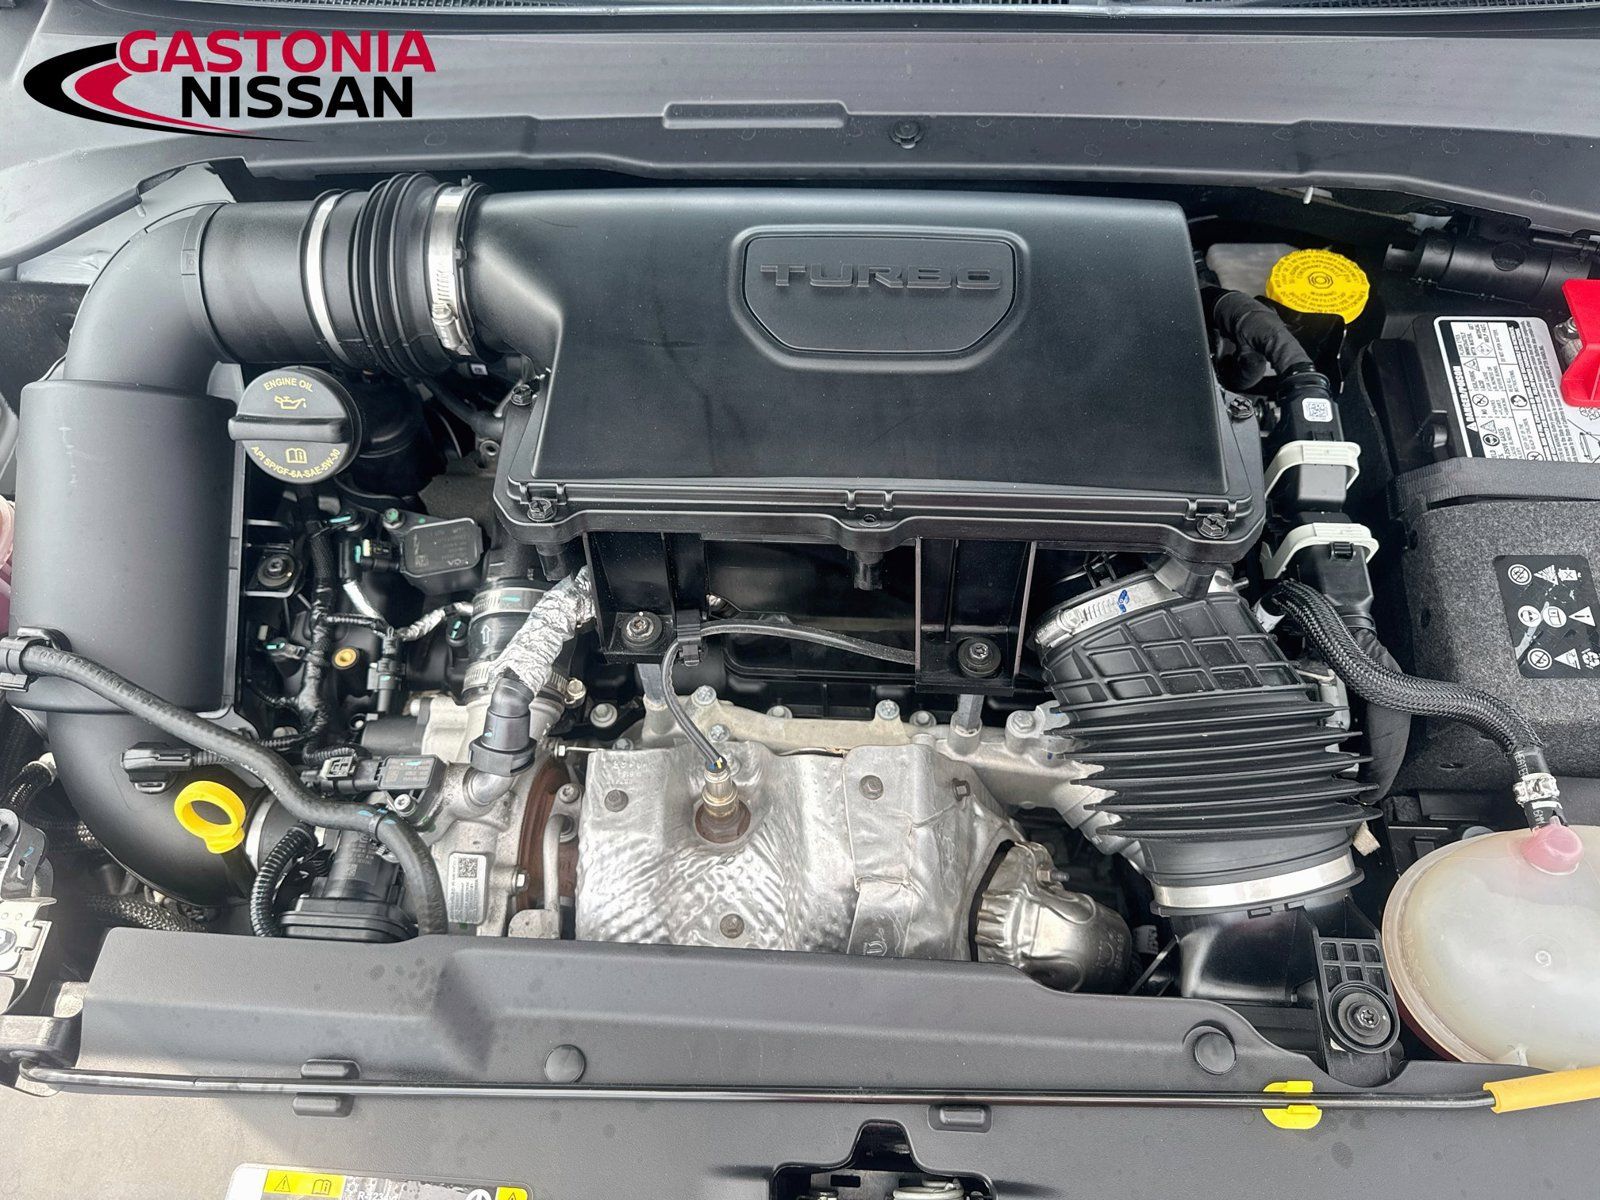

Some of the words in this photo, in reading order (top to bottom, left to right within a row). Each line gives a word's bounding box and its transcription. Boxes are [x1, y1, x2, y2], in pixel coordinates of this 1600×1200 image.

[760, 263, 1000, 289] TURBO
[263, 378, 297, 391] ENGINE
[299, 379, 313, 392] OIL
[251, 446, 264, 460] API
